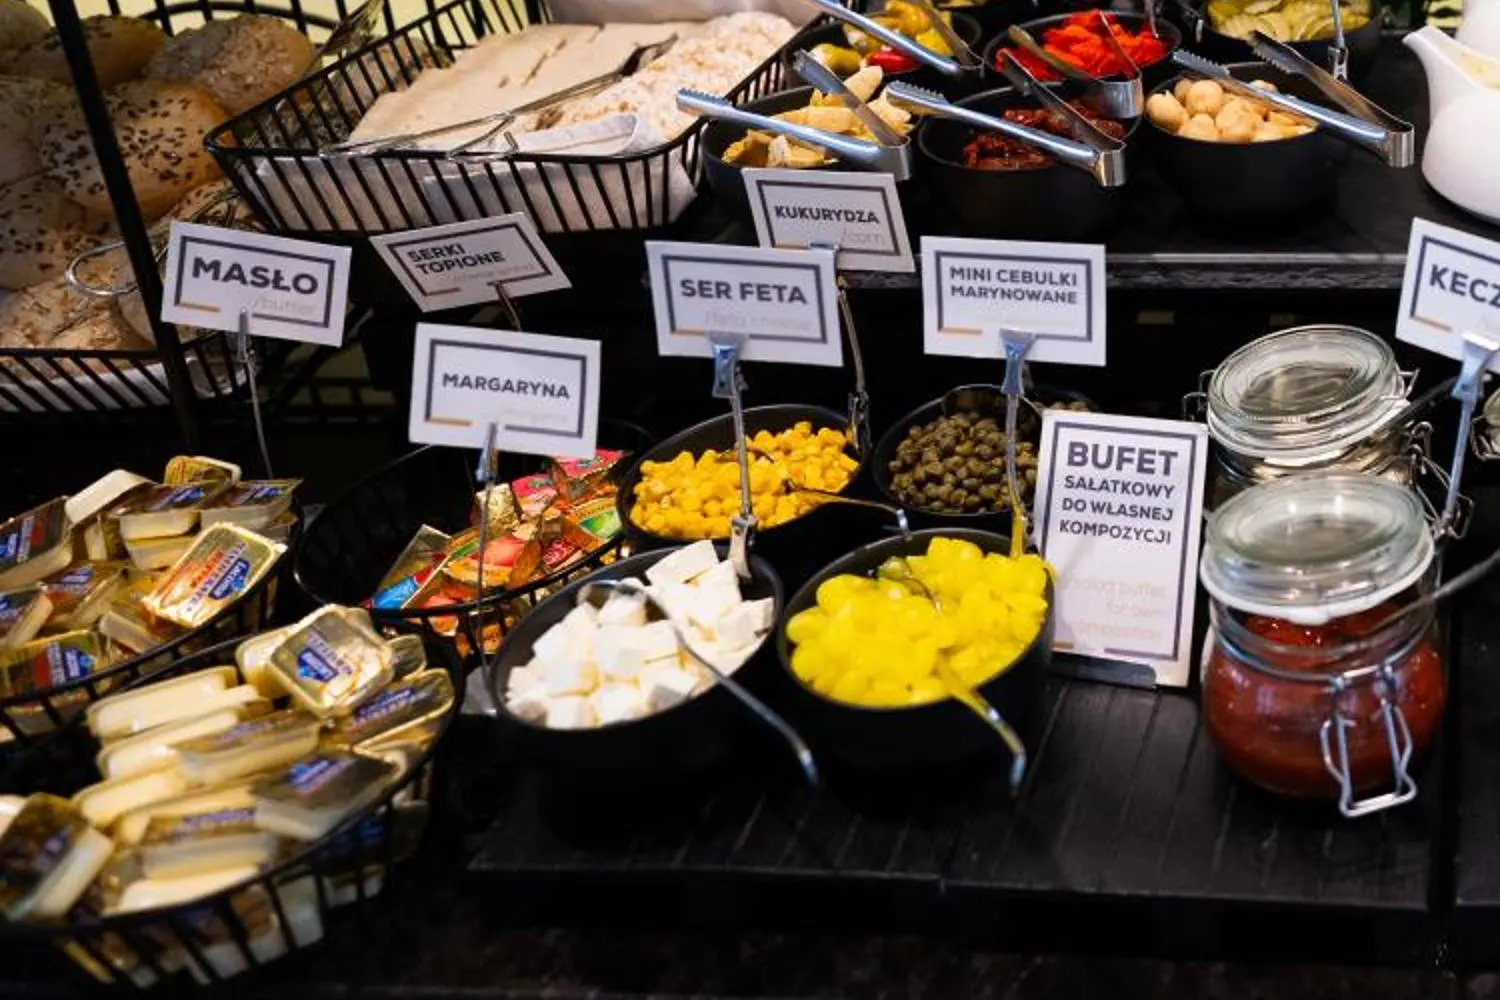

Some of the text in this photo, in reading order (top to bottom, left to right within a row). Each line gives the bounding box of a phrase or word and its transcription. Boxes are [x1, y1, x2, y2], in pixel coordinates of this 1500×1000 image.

[774, 205, 880, 224] KUKURYDZA
[407, 243, 466, 263] SERKI
[417, 250, 506, 276] TOPIONE
[192, 257, 318, 295] MASŁO
[951, 266, 1077, 287] MINI CEBULKI
[680, 279, 807, 305] SER FETA
[951, 285, 1077, 305] MARYNOWANE
[442, 372, 570, 400] MARGARYNA
[1067, 441, 1178, 477] BUFET
[1064, 475, 1175, 499] SAŁATKOWY
[1062, 497, 1173, 522] DO WŁASNEJ
[1059, 519, 1172, 545] KOMPOZYCJI
